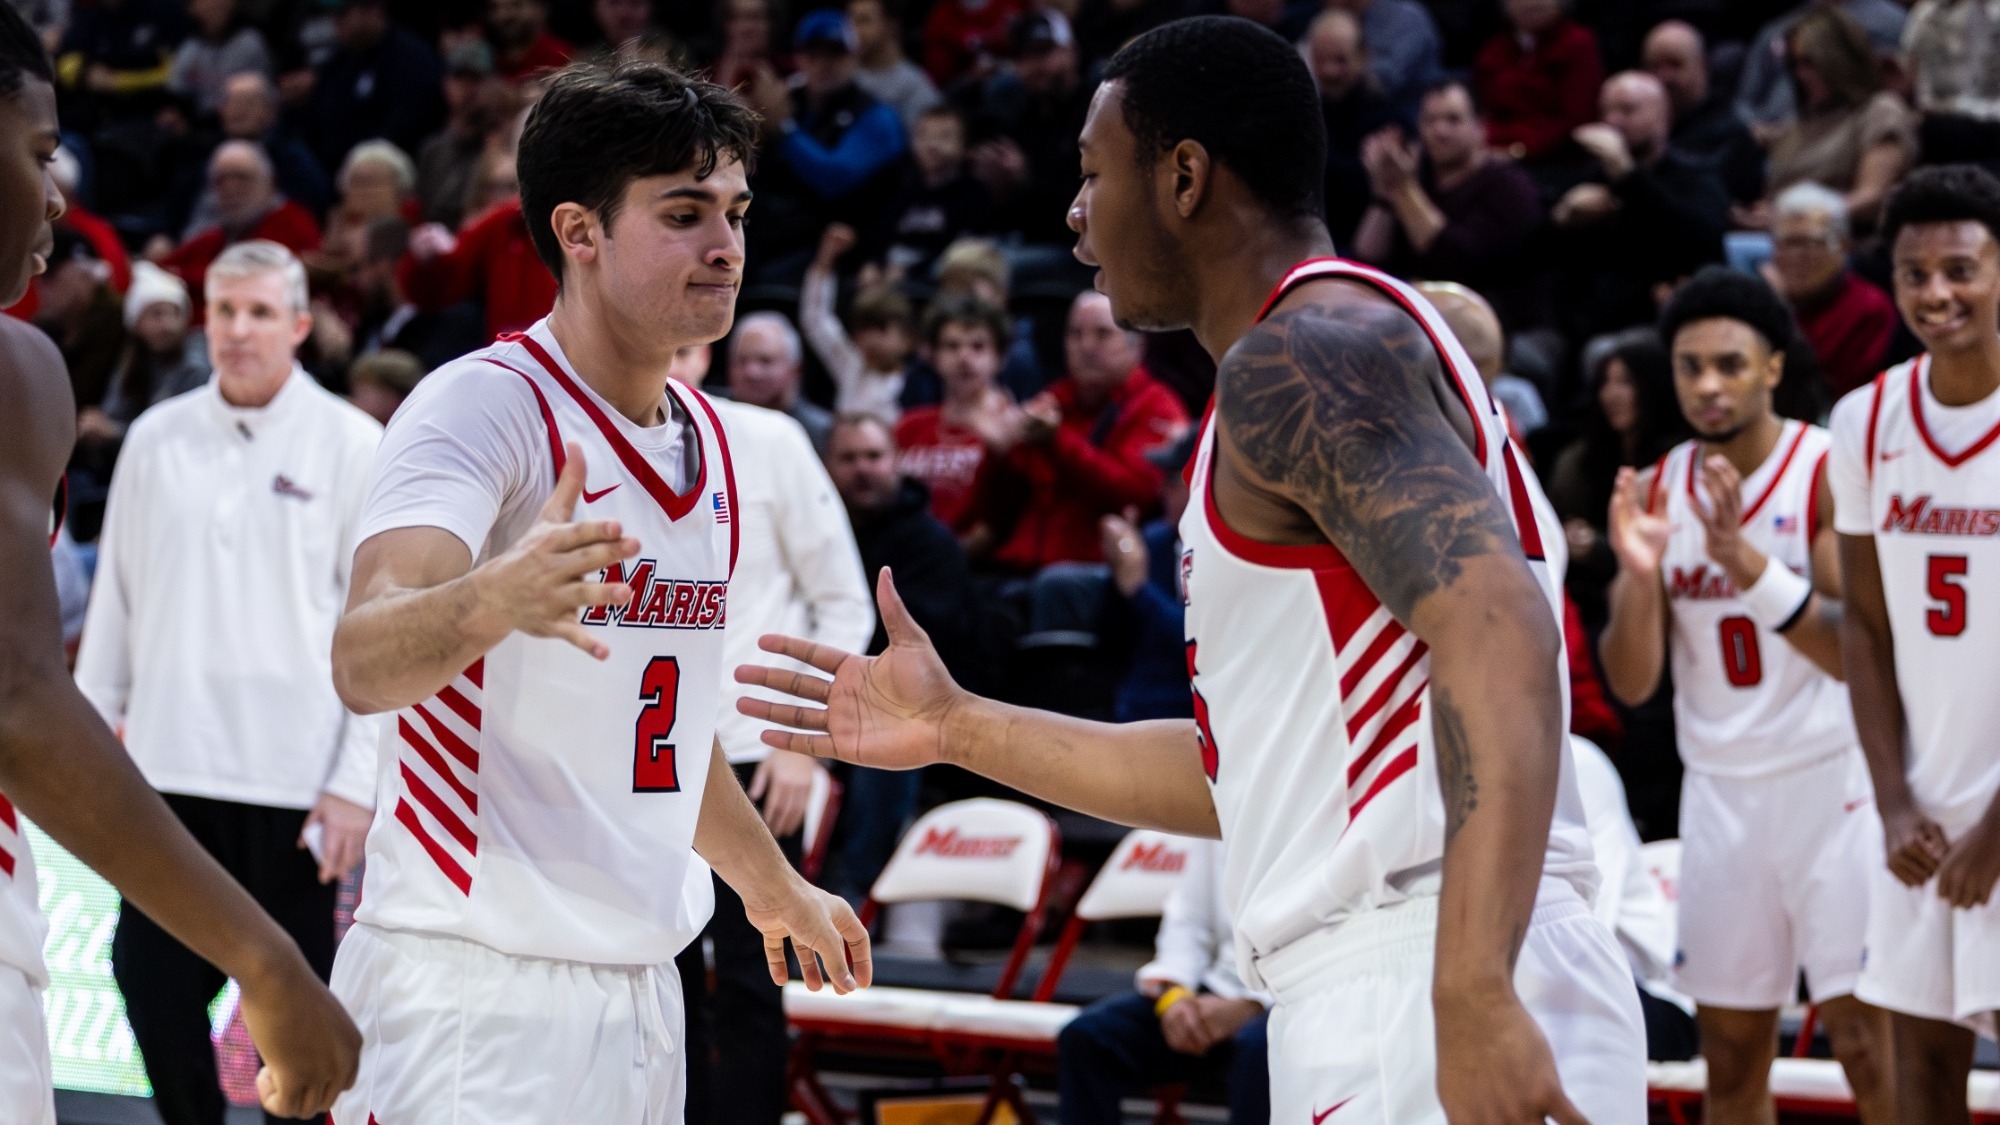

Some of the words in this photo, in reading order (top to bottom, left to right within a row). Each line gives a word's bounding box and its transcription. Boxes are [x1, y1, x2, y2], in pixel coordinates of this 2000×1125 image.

[1881, 494, 2000, 536] MARIS
[1926, 554, 1968, 637] 5
[1719, 614, 1762, 688] 0
[632, 656, 681, 793] 2
[43, 988, 133, 1063] IZZA
